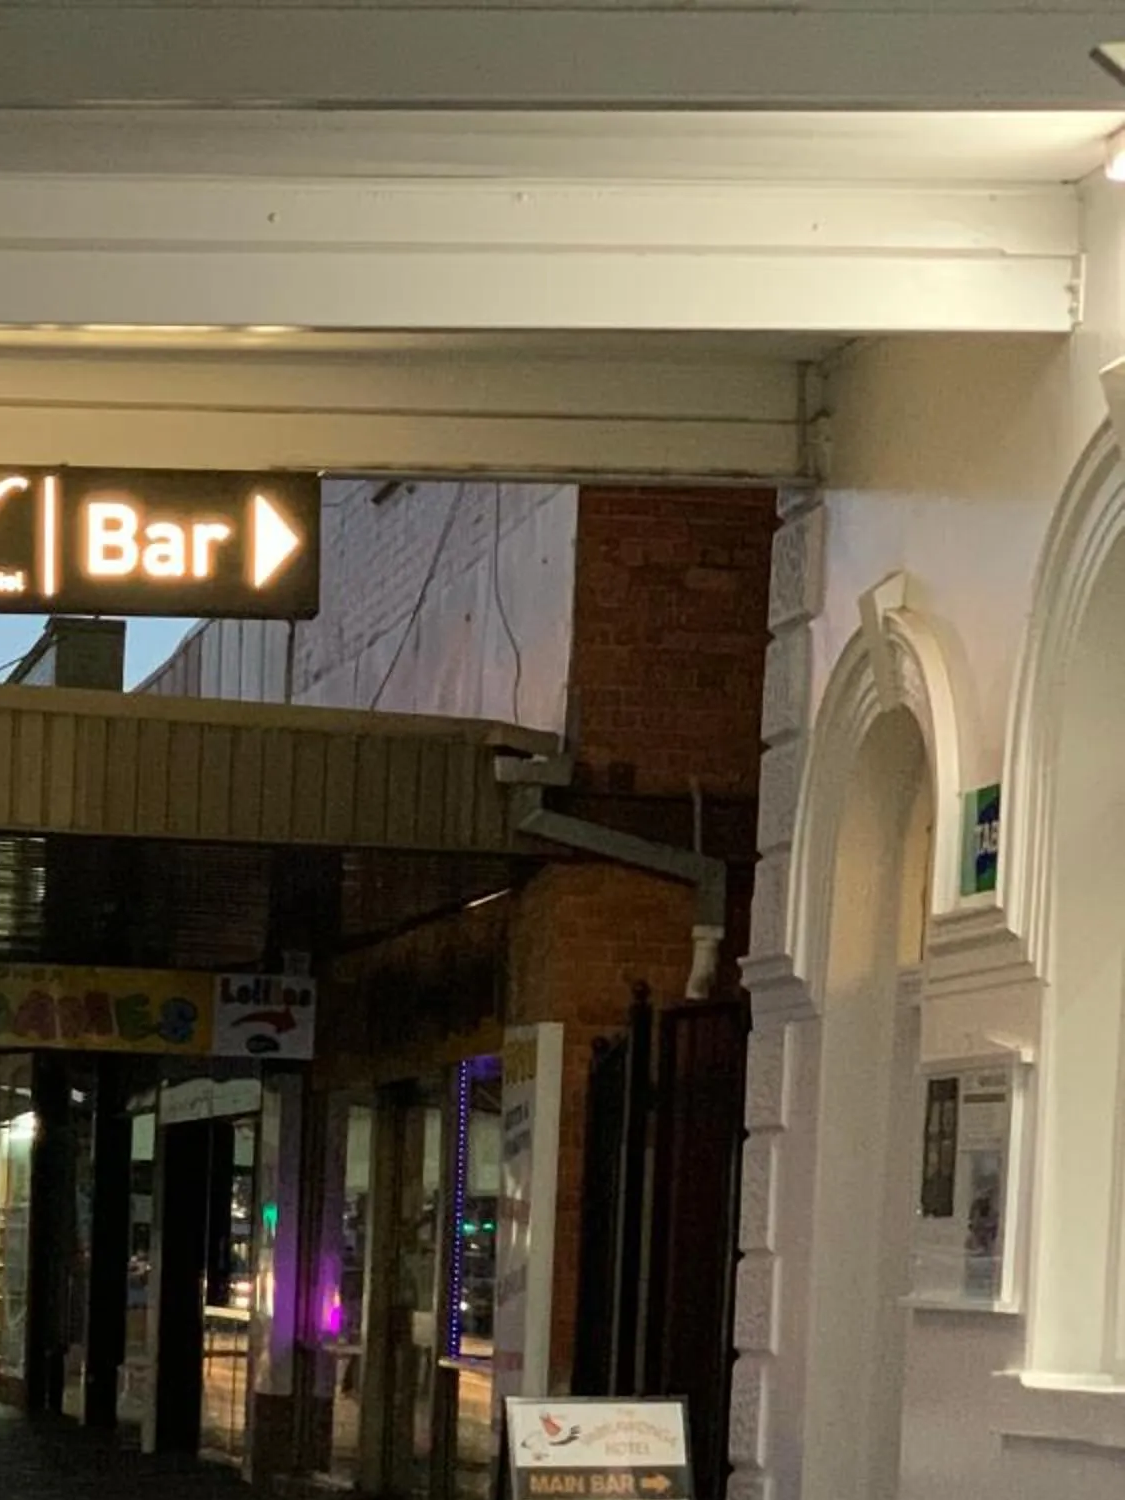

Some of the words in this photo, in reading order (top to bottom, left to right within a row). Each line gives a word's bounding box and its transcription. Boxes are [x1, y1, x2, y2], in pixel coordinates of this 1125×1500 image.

[87, 502, 231, 577] Bar
[530, 1473, 585, 1494] MAIN
[589, 1473, 636, 1494] BAR
